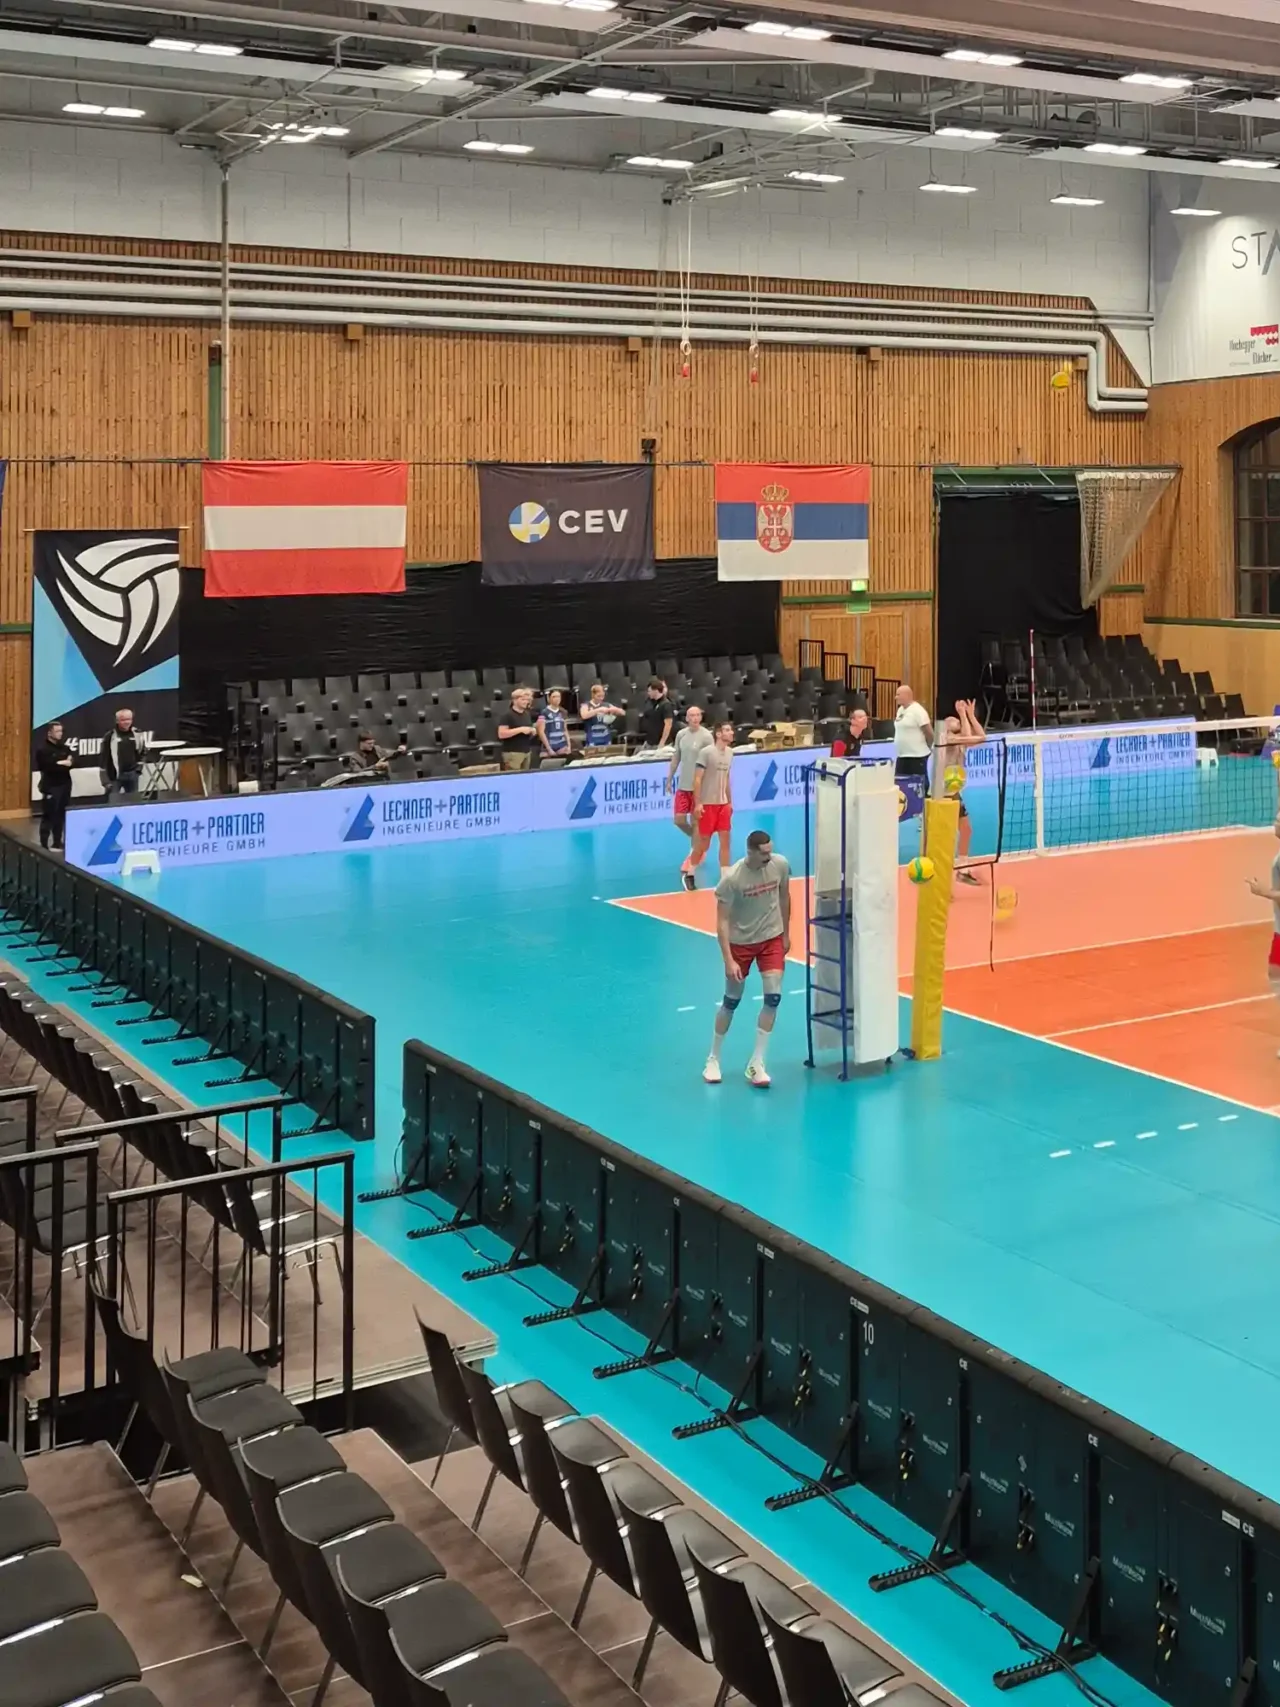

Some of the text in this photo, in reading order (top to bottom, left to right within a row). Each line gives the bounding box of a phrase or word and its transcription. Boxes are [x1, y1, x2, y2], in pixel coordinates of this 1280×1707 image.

[558, 508, 629, 535] CEV
[604, 778, 647, 802] LECHNER
[382, 797, 433, 823] LECHNER
[450, 791, 500, 817] PARTNER
[603, 799, 672, 815] INGENIEURE
[131, 818, 188, 845] LECHNER
[207, 812, 265, 839] PARTNER
[382, 815, 501, 836] INGENIEURE GMBH
[226, 838, 266, 851] GMBH
[863, 1320, 875, 1345] 10
[1242, 1522, 1255, 1538] CE
